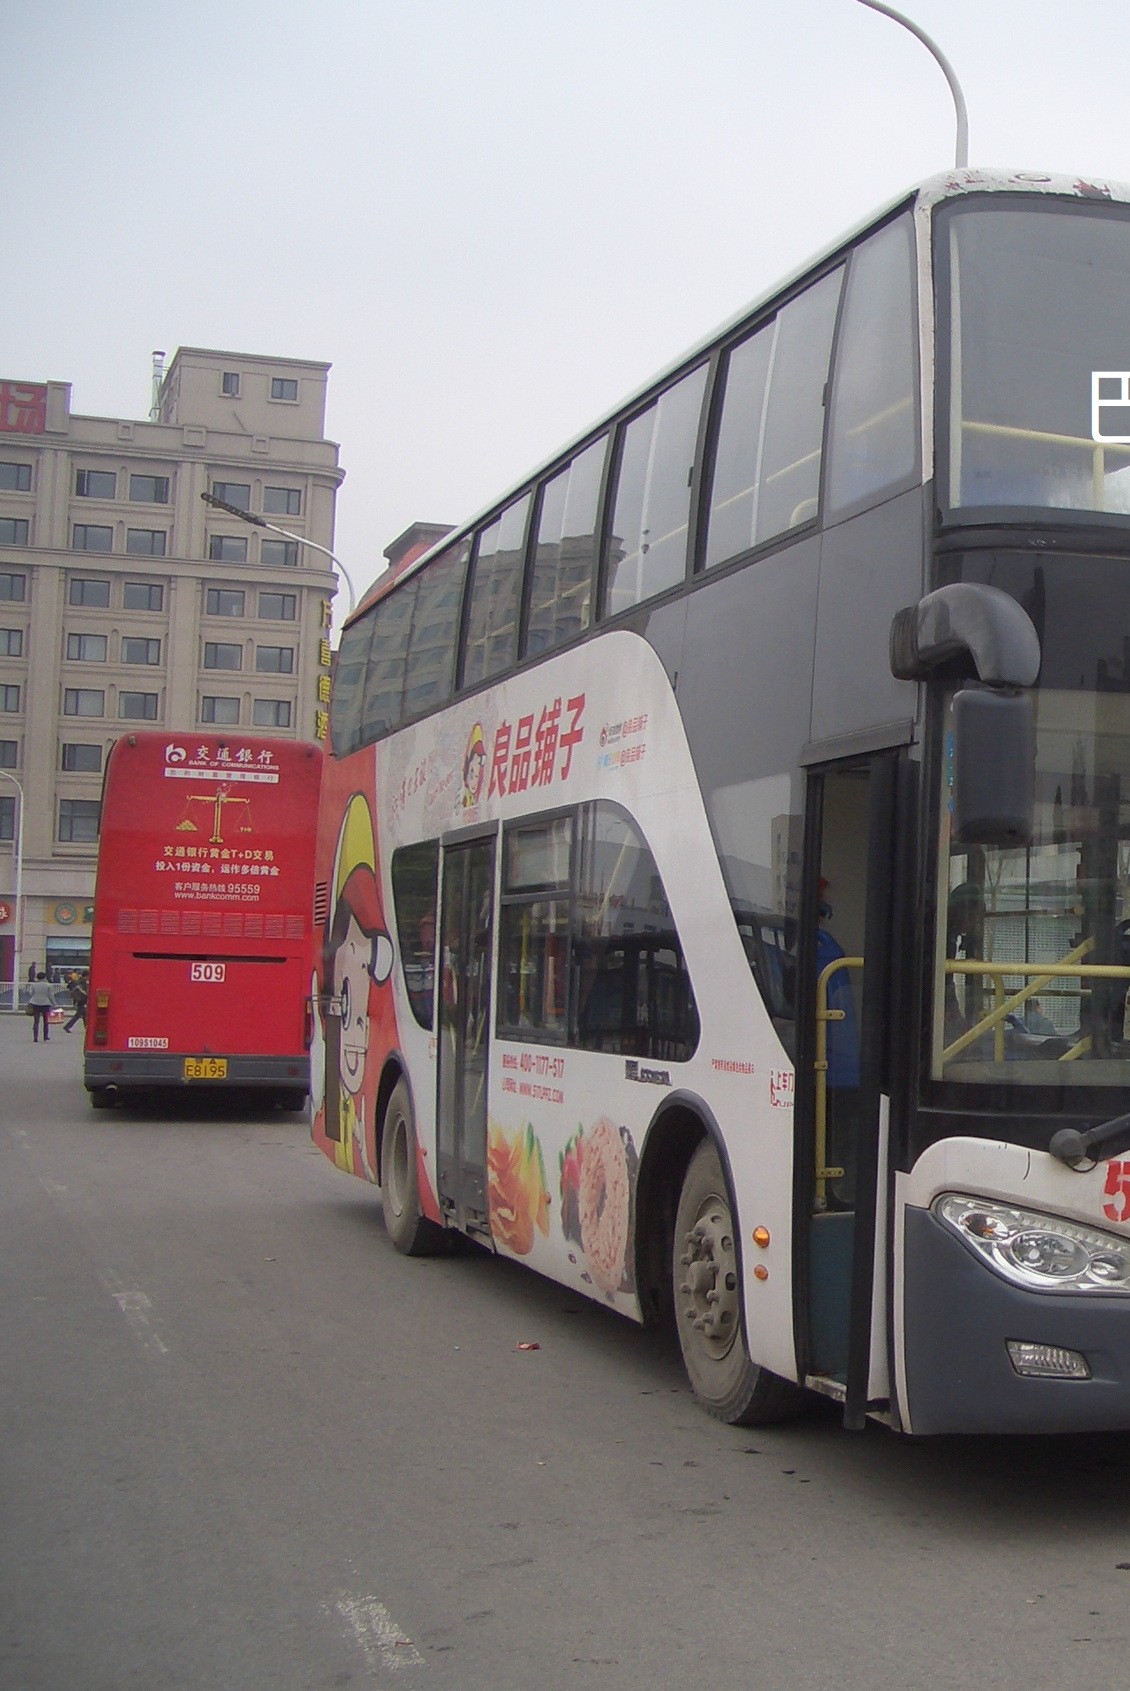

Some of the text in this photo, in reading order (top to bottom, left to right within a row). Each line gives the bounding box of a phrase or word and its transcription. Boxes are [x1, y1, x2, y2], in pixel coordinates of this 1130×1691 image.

[487, 692, 586, 801] 良品铺子
[221, 761, 280, 771] COMMUNICATIONS
[163, 845, 275, 862] 交通银行黄金T+D交易
[227, 883, 261, 895] 95559
[174, 891, 260, 902] www.bankcomm.com
[192, 963, 224, 981] 509
[129, 1037, 168, 1049] 109S1045
[186, 1064, 226, 1077] E8195
